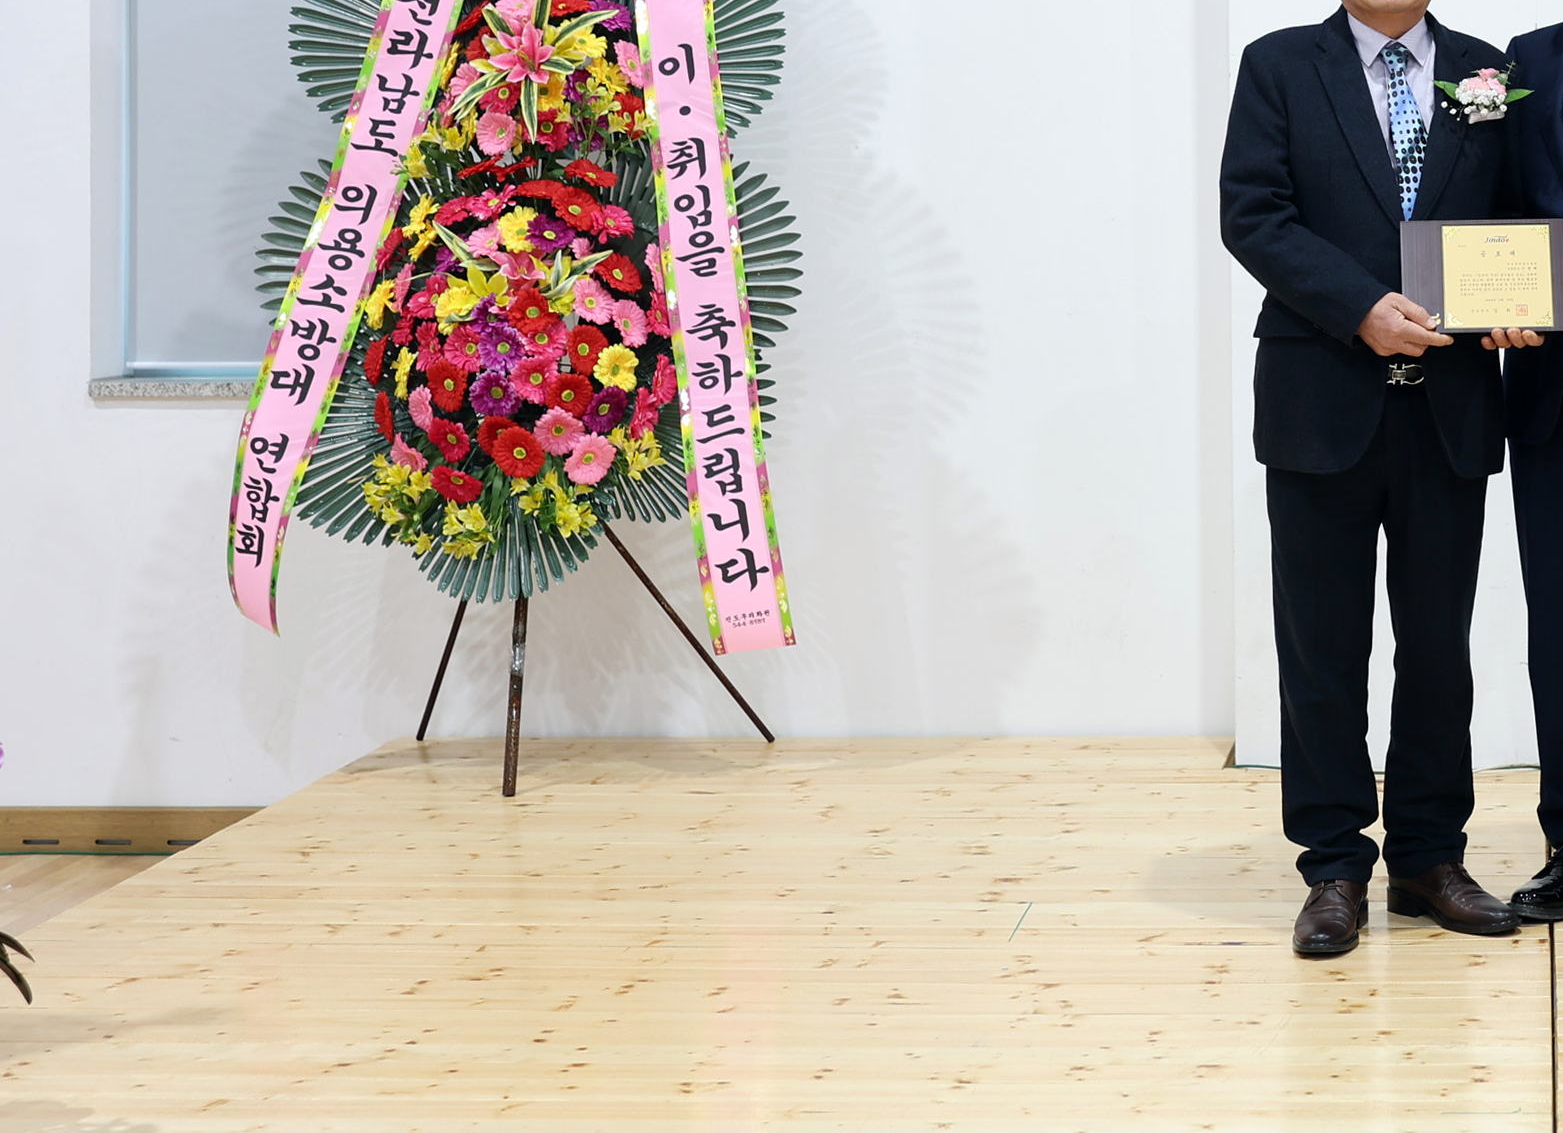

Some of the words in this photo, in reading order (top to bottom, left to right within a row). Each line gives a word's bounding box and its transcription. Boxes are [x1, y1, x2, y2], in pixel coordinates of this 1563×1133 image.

[269, 183, 379, 407] 의용소방대
[234, 433, 290, 568] 연합회
[685, 304, 770, 592] 축하드립니다
